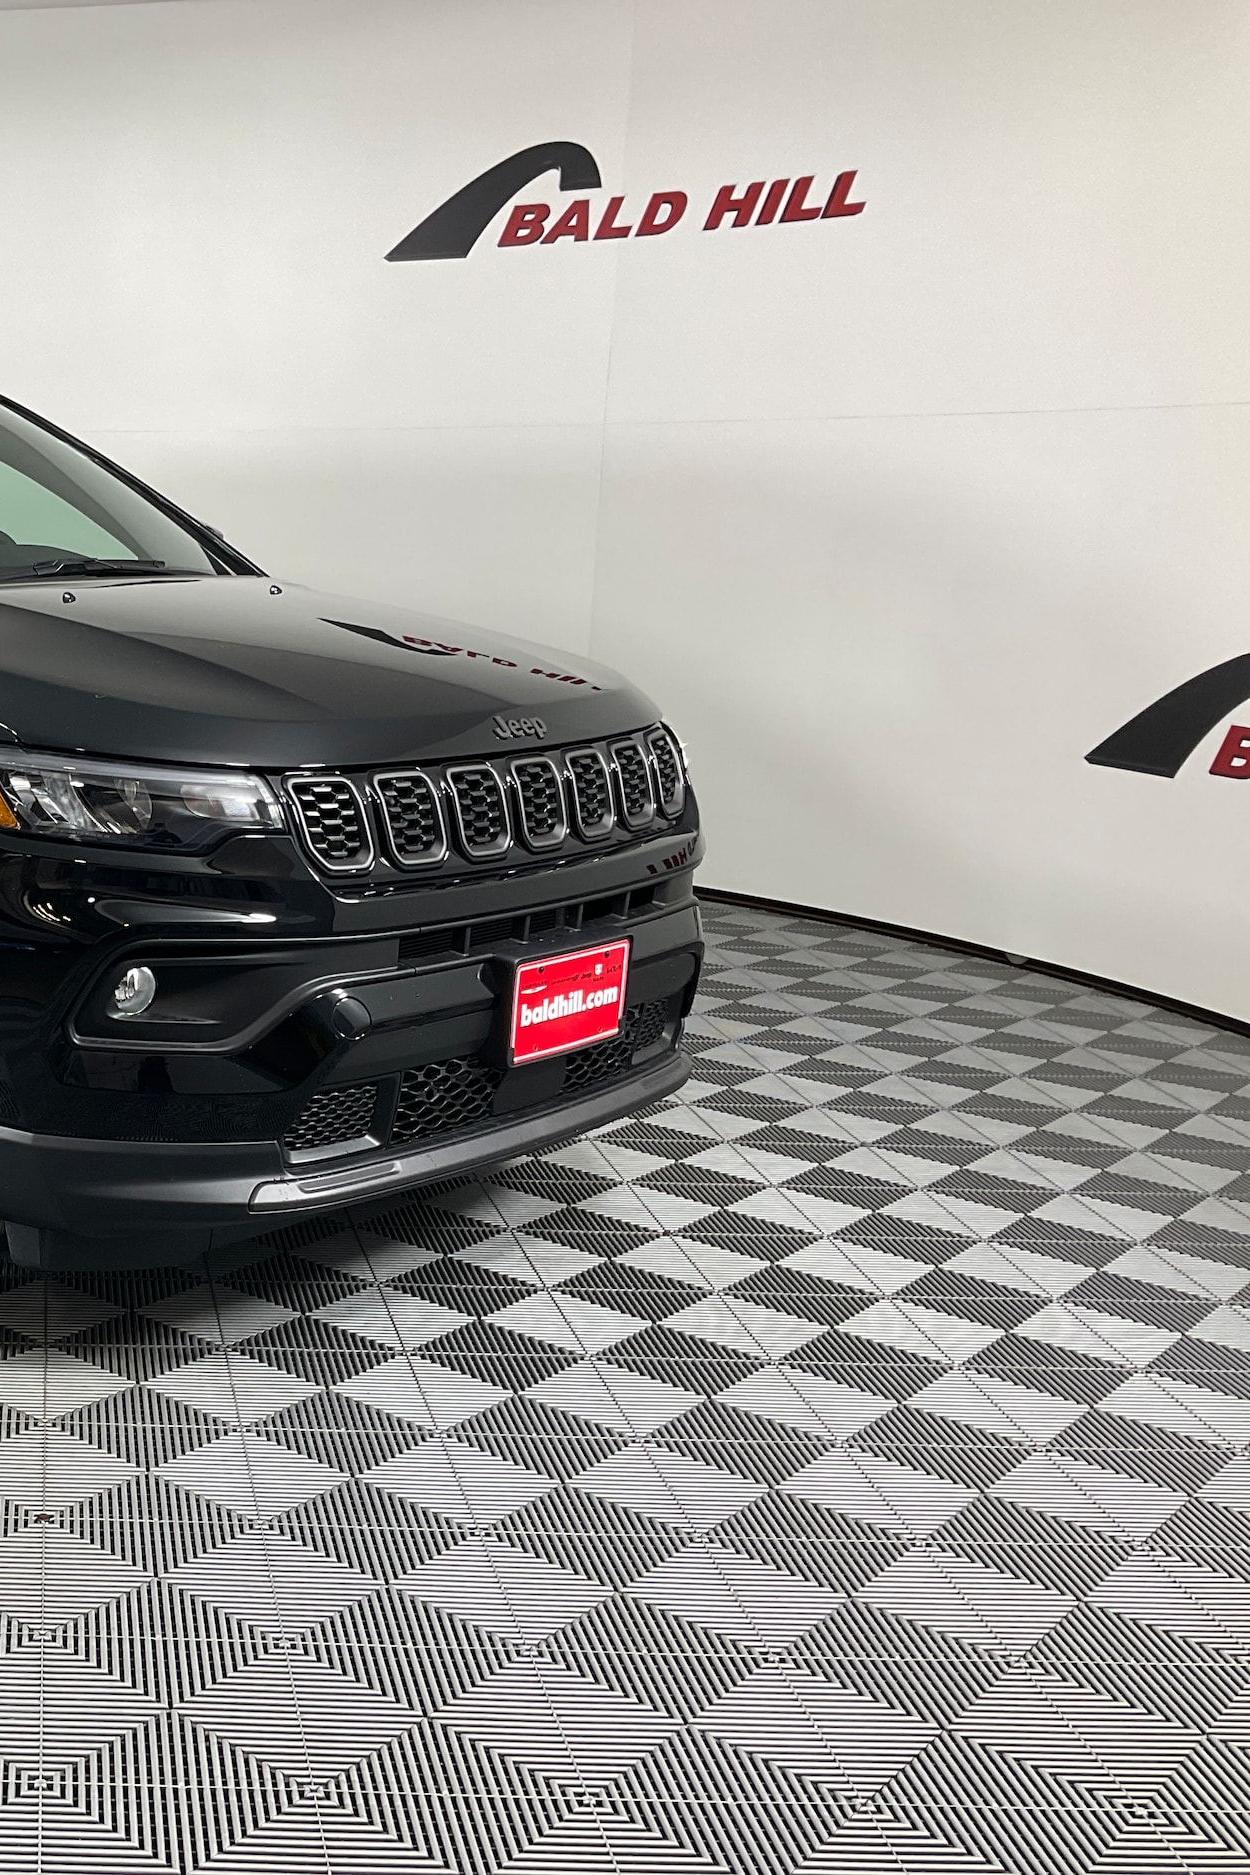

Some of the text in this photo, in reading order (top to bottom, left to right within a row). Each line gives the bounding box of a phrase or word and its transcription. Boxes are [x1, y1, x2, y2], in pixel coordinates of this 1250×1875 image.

[497, 170, 867, 248] BALD HILL
[492, 714, 548, 740] Jeep
[520, 986, 619, 1028] baldhill.com
